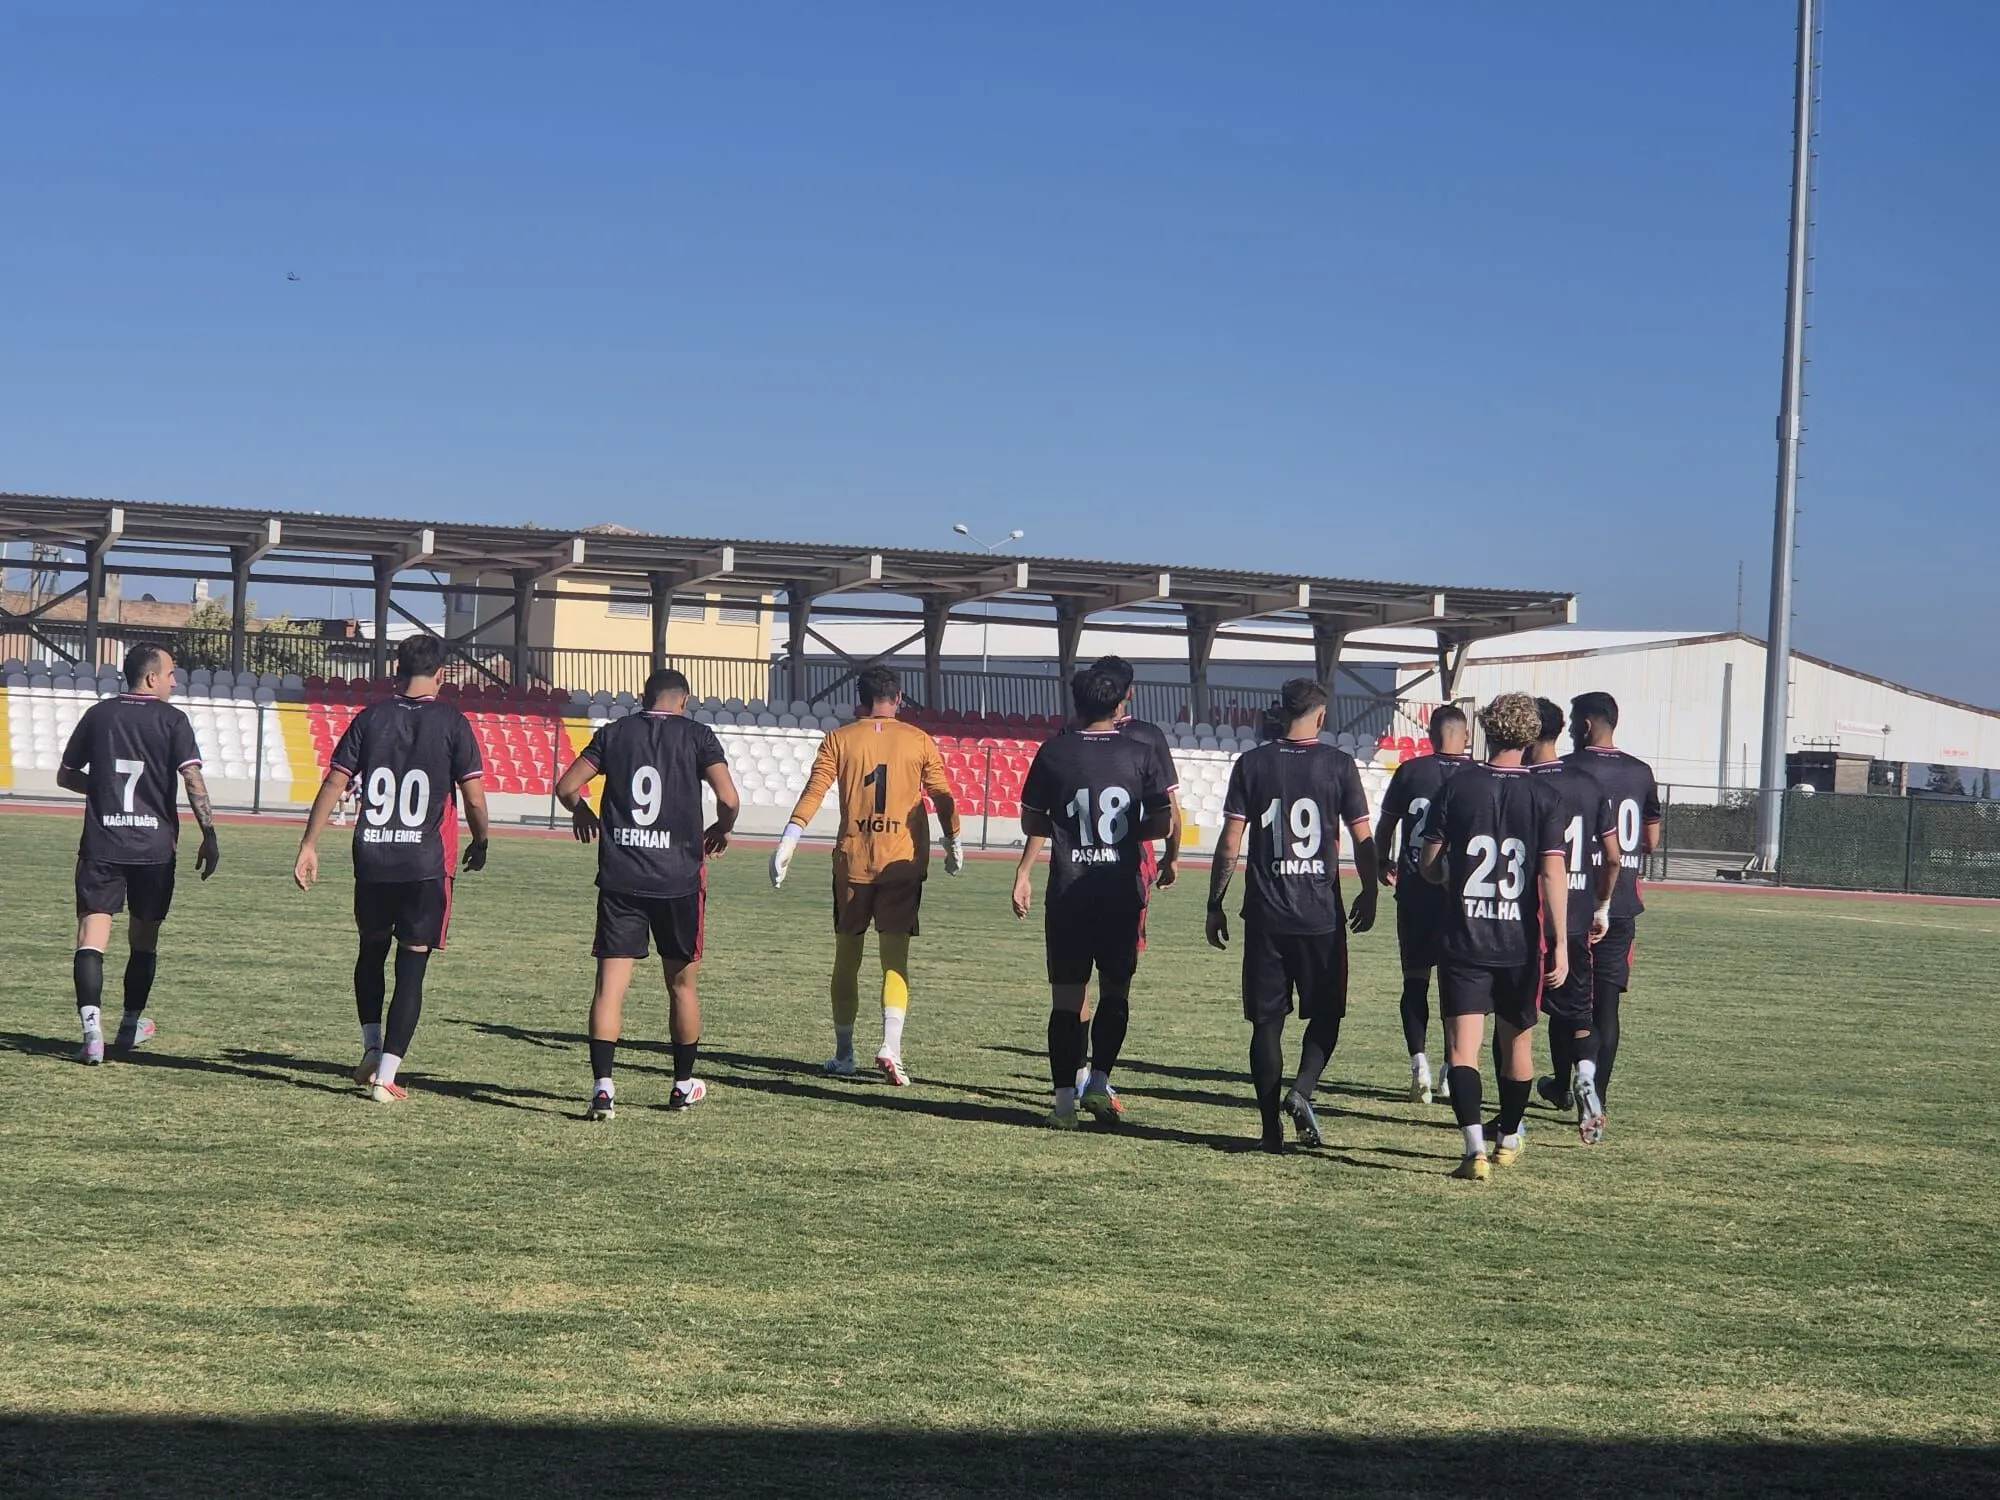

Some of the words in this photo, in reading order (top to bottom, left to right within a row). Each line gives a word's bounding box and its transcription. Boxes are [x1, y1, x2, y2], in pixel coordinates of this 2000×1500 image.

[115, 759, 145, 812] 7
[365, 766, 430, 827] 90
[631, 765, 662, 826] 9
[863, 763, 888, 815] 1
[363, 827, 394, 843] SELİM
[394, 830, 422, 843] EMRE
[613, 827, 671, 849] BERHAN
[855, 817, 901, 834] YİĞİT
[1066, 786, 1131, 846] 18
[1261, 798, 1322, 859] 19
[1408, 797, 1432, 849] 2
[1271, 860, 1326, 877] ÇINAR
[1463, 835, 1526, 900] 23
[1564, 815, 1584, 872] 1
[1465, 899, 1522, 921] TALHA
